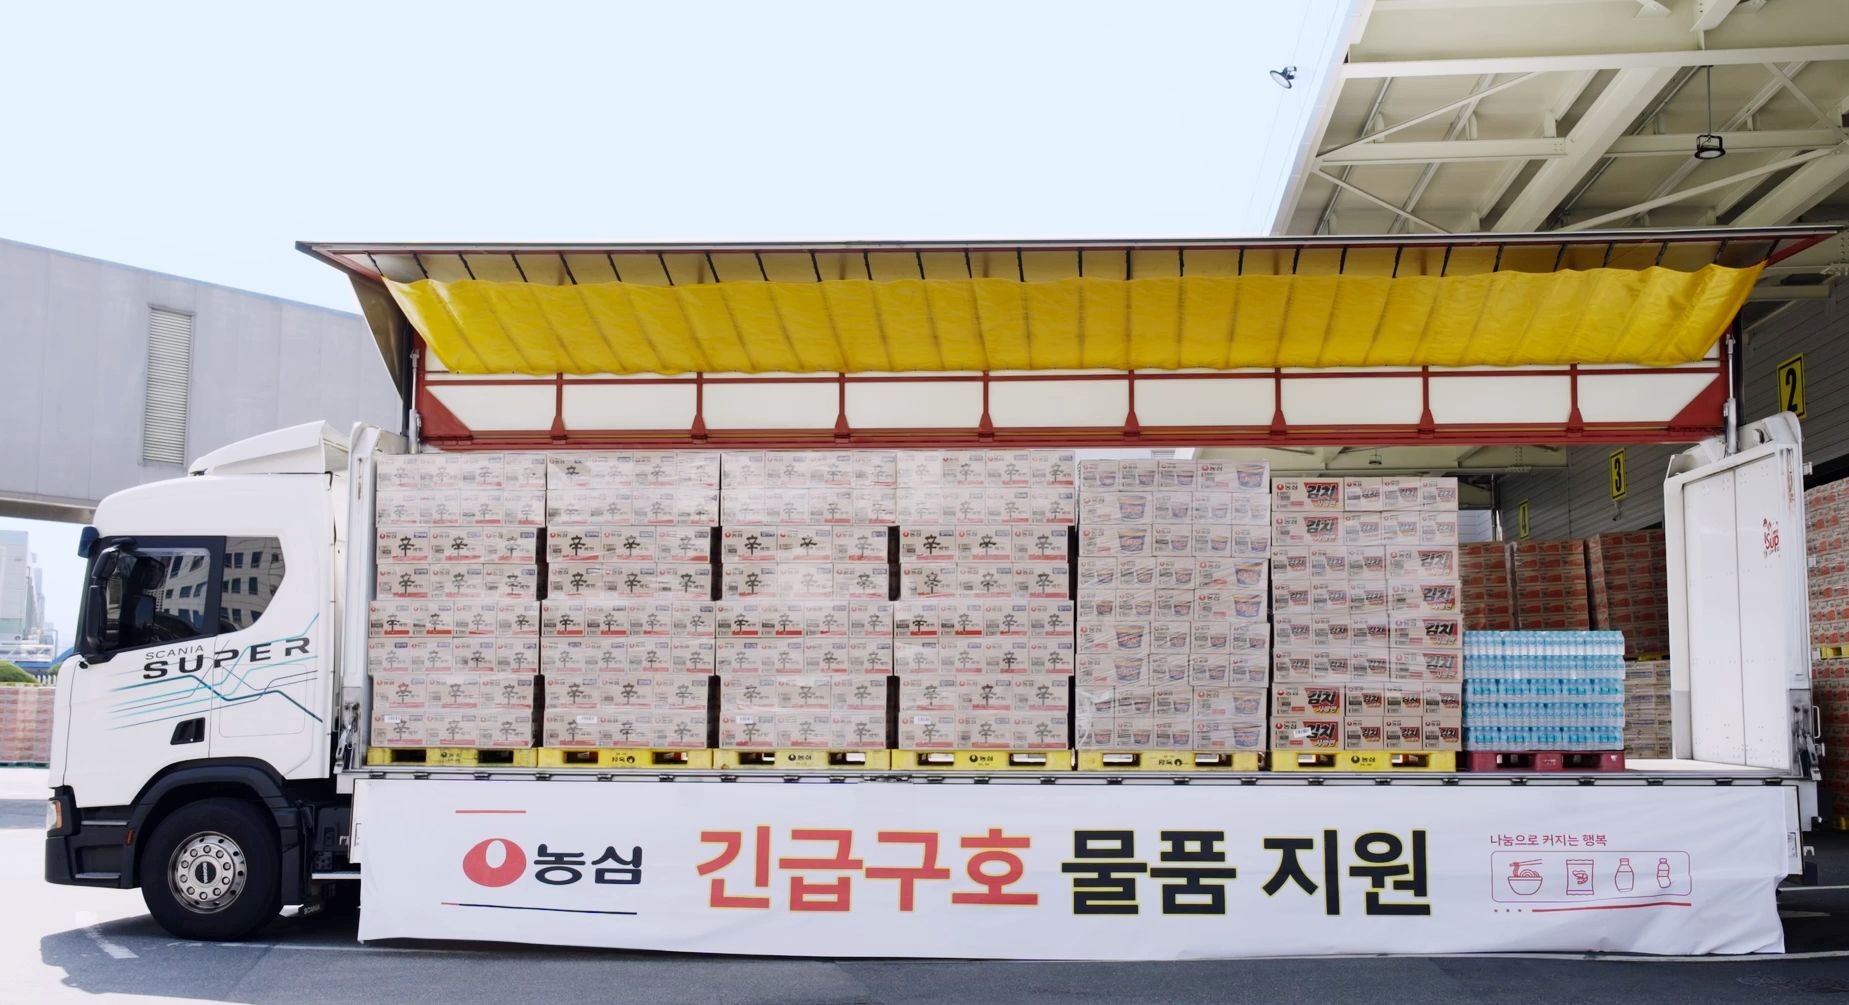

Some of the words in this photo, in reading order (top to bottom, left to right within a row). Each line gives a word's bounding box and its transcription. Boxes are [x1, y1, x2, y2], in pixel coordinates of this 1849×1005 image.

[1785, 367, 1798, 412] 2
[1614, 457, 1622, 494] 3
[1307, 485, 1335, 499] 김치
[1307, 519, 1333, 533] 김치
[1520, 505, 1528, 534] 4
[398, 536, 416, 557] 辛
[452, 536, 469, 557] 辛
[504, 536, 521, 557] 辛
[569, 536, 587, 557] 辛
[623, 536, 641, 557] 辛
[677, 536, 695, 557] 辛
[745, 535, 762, 556] 辛
[800, 535, 818, 556] 辛
[855, 535, 873, 556] 辛
[923, 535, 941, 556] 辛
[979, 535, 997, 556] 辛
[1036, 535, 1054, 556] 辛
[1421, 554, 1448, 566] 김치
[398, 572, 416, 593] 辛
[451, 572, 469, 593] 辛
[505, 572, 523, 593] 辛
[571, 572, 589, 593] 辛
[624, 572, 642, 593] 辛
[679, 572, 696, 593] 辛
[745, 572, 763, 593] 辛
[801, 572, 819, 593] 辛
[856, 572, 874, 593] 辛
[924, 572, 942, 593] 辛
[980, 572, 998, 593] 辛
[1036, 572, 1054, 593] 辛
[1423, 588, 1452, 601] 김치
[386, 613, 401, 631] 辛
[429, 613, 443, 631] 辛
[471, 613, 486, 631] 辛
[515, 613, 530, 631] 辛
[559, 613, 574, 631] 辛
[603, 613, 617, 631] 辛
[645, 613, 660, 631] 辛
[689, 613, 704, 631] 辛
[735, 613, 749, 631] 辛
[779, 613, 793, 631] 辛
[822, 613, 837, 631] 辛
[867, 613, 882, 631] 辛
[913, 613, 928, 631] 辛
[958, 613, 973, 631] 辛
[1003, 613, 1018, 631] 辛
[1047, 613, 1062, 631] 辛
[1426, 623, 1454, 635] 김치
[143, 637, 310, 680] SUPER
[145, 644, 204, 660] SCANIA
[385, 650, 400, 669] 辛
[428, 650, 443, 669] 辛
[471, 650, 486, 669] 辛
[513, 650, 528, 669] 辛
[558, 650, 573, 669] 辛
[601, 650, 616, 669] 辛
[645, 650, 660, 669] 辛
[689, 650, 704, 669] 辛
[735, 651, 749, 669] 辛
[779, 651, 793, 669] 辛
[823, 651, 838, 669] 辛
[867, 651, 882, 669] 辛
[913, 651, 928, 669] 辛
[958, 651, 973, 669] 辛
[1003, 651, 1018, 669] 辛
[1049, 651, 1064, 669] 辛
[1426, 656, 1453, 668] 김치
[395, 683, 413, 703] 辛
[448, 683, 466, 703] 辛
[501, 683, 519, 703] 辛
[567, 683, 584, 703] 辛
[621, 683, 639, 703] 辛
[675, 683, 693, 703] 辛
[743, 684, 761, 705] 辛
[799, 684, 817, 705] 辛
[854, 684, 872, 705] 辛
[923, 684, 941, 705] 辛
[979, 684, 997, 705] 辛
[1036, 684, 1054, 705] 辛
[1308, 691, 1335, 704] 김치
[393, 720, 411, 742] 辛
[446, 720, 464, 742] 辛
[500, 720, 518, 742] 辛
[565, 720, 583, 742] 辛
[618, 720, 636, 742] 辛
[673, 720, 691, 742] 辛
[743, 722, 761, 742] 辛
[798, 722, 816, 742] 辛
[854, 722, 871, 742] 辛
[923, 722, 941, 742] 辛
[979, 722, 997, 742] 辛
[1035, 722, 1053, 742] 辛
[1306, 724, 1334, 738] 김치
[1490, 834, 1539, 847] 나눔으로
[1542, 834, 1579, 847] 커지는
[1582, 834, 1607, 847] 행복
[533, 843, 643, 886] 농심
[696, 825, 1039, 912] 긴급구호
[1060, 829, 1237, 915] 물품
[1261, 829, 1432, 916] 지원
